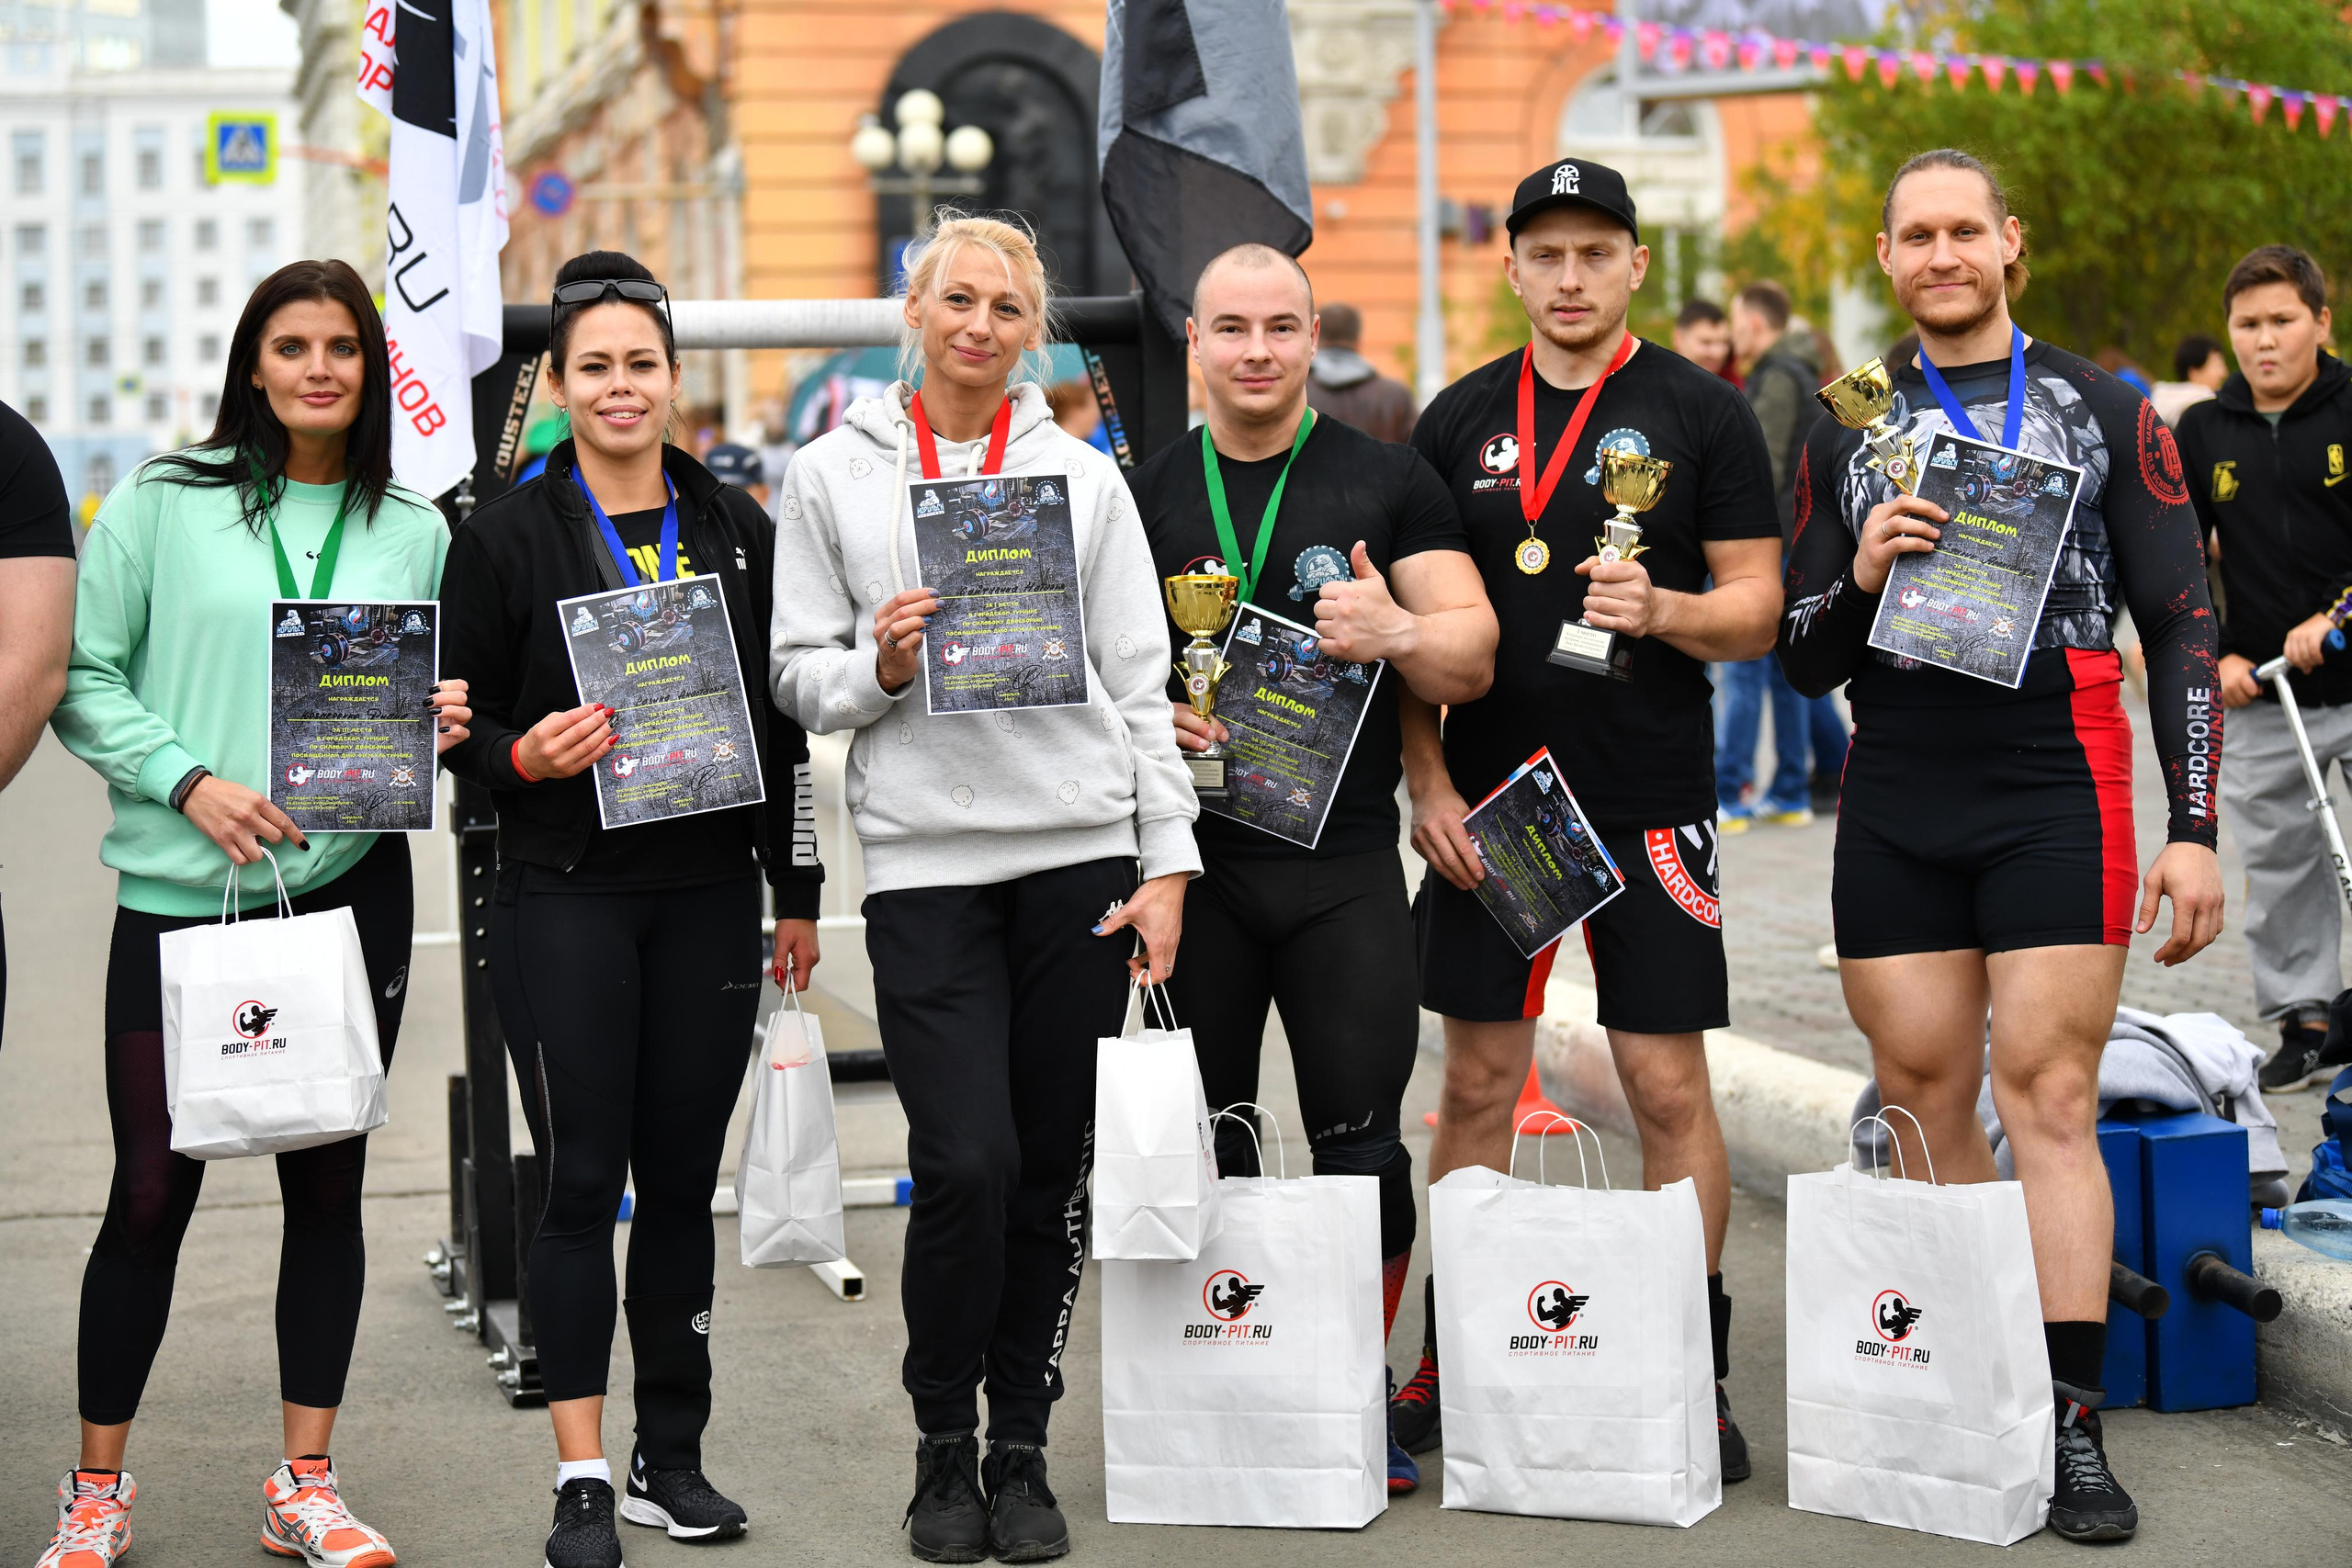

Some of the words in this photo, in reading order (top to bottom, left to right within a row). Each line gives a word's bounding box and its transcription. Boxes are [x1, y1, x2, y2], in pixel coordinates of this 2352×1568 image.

[1473, 478, 1521, 490] BODY-PIT.R
[1953, 511, 2018, 538] ДИПЛОМ
[1958, 533, 2003, 550] НАГРАЖДАЕТСЯ
[965, 547, 1032, 563] ДИПЛОМ
[1926, 599, 1979, 621] BODY-PIT.RU
[972, 643, 1027, 656] BODY-PIT.RU
[625, 654, 691, 676] ДИПЛОМ
[319, 675, 389, 687] ДИПЛОМ
[637, 675, 685, 688] НАГРАЖДАЕТСЯ
[1253, 686, 1316, 718] ДИПЛОМ
[643, 749, 697, 766] BODY-PIT.RU
[317, 770, 375, 779] BODY-PIT.RU
[1524, 822, 1563, 881] ДИПЛОМ
[221, 1038, 286, 1055] BODY-PIT.RU
[1184, 1325, 1272, 1338] BODY-PIT.RU
[1510, 1336, 1598, 1349] BODY-PIT.RU
[1856, 1340, 1930, 1363] BODY-PIT.RU
[1855, 1356, 1894, 1366] СПОРТИВНОЕ
[1898, 1361, 1928, 1371] ПИТАНИЕ
